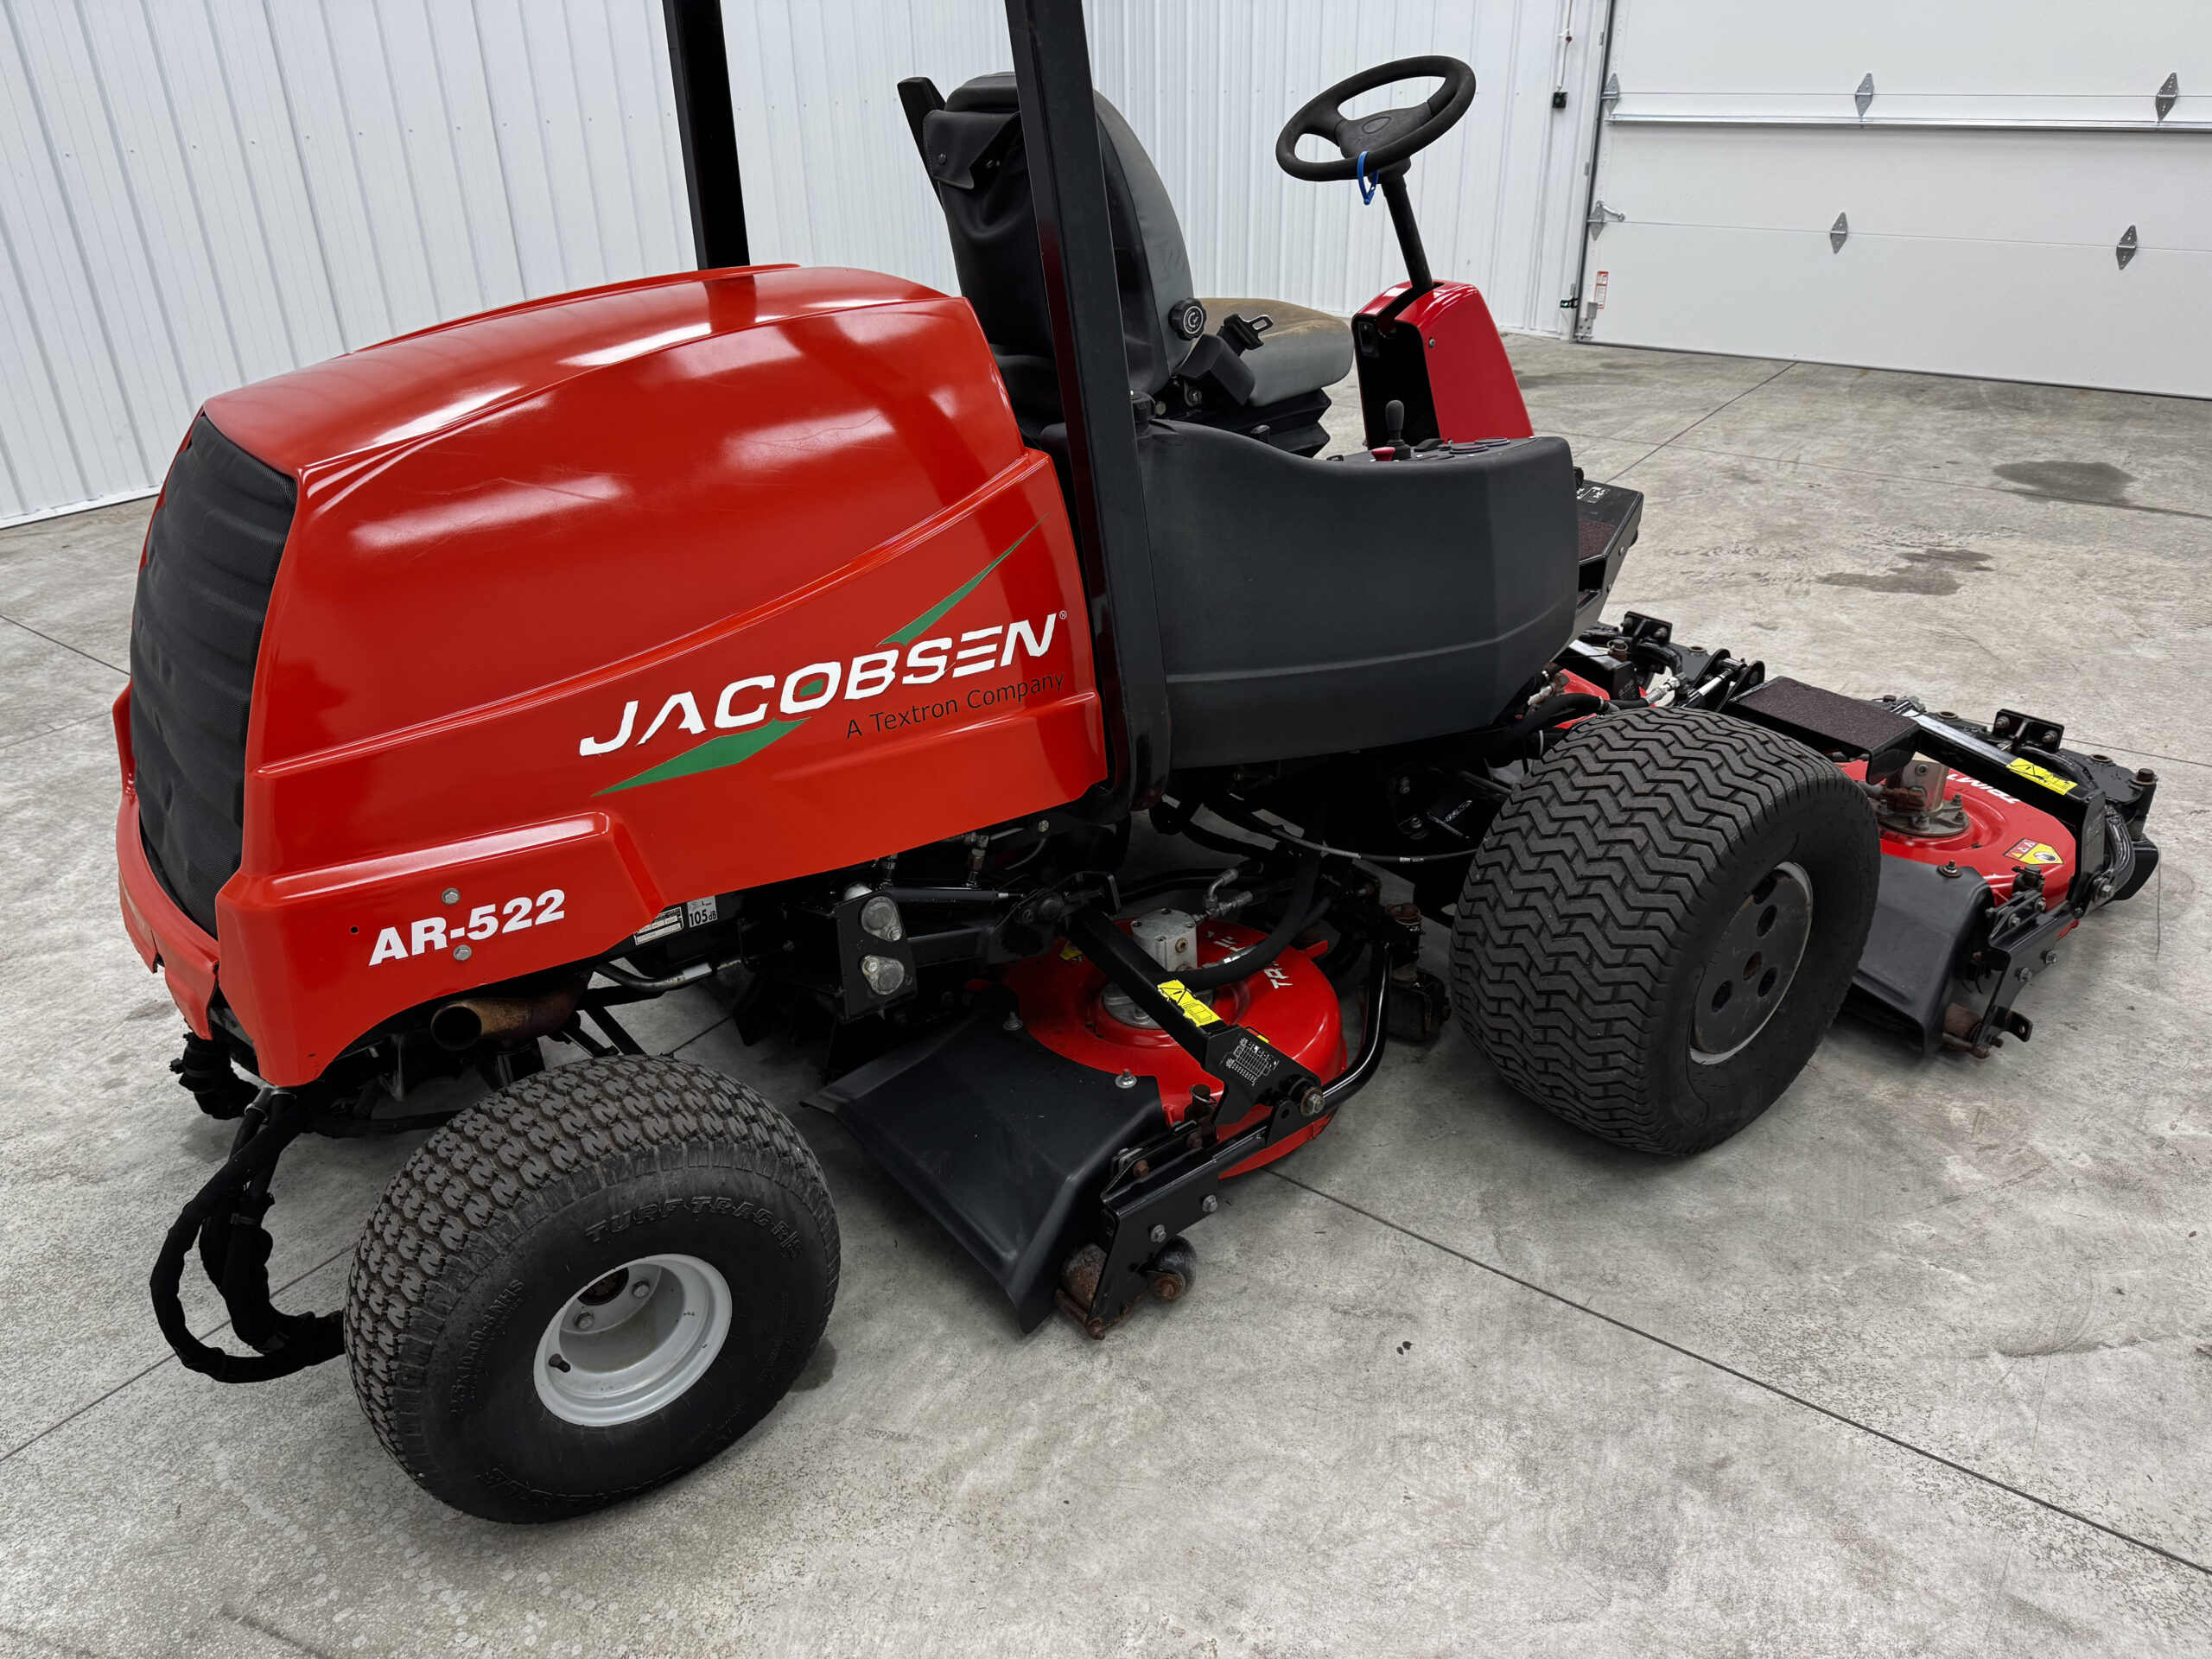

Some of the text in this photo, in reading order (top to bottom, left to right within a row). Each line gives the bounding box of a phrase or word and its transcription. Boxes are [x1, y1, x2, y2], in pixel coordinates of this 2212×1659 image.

[847, 672, 1065, 739] A Textron Company
[368, 888, 566, 967] AR-522
[689, 909, 717, 926] 105 dB
[584, 1197, 684, 1243] TURF
[691, 1195, 774, 1226] TRAC
